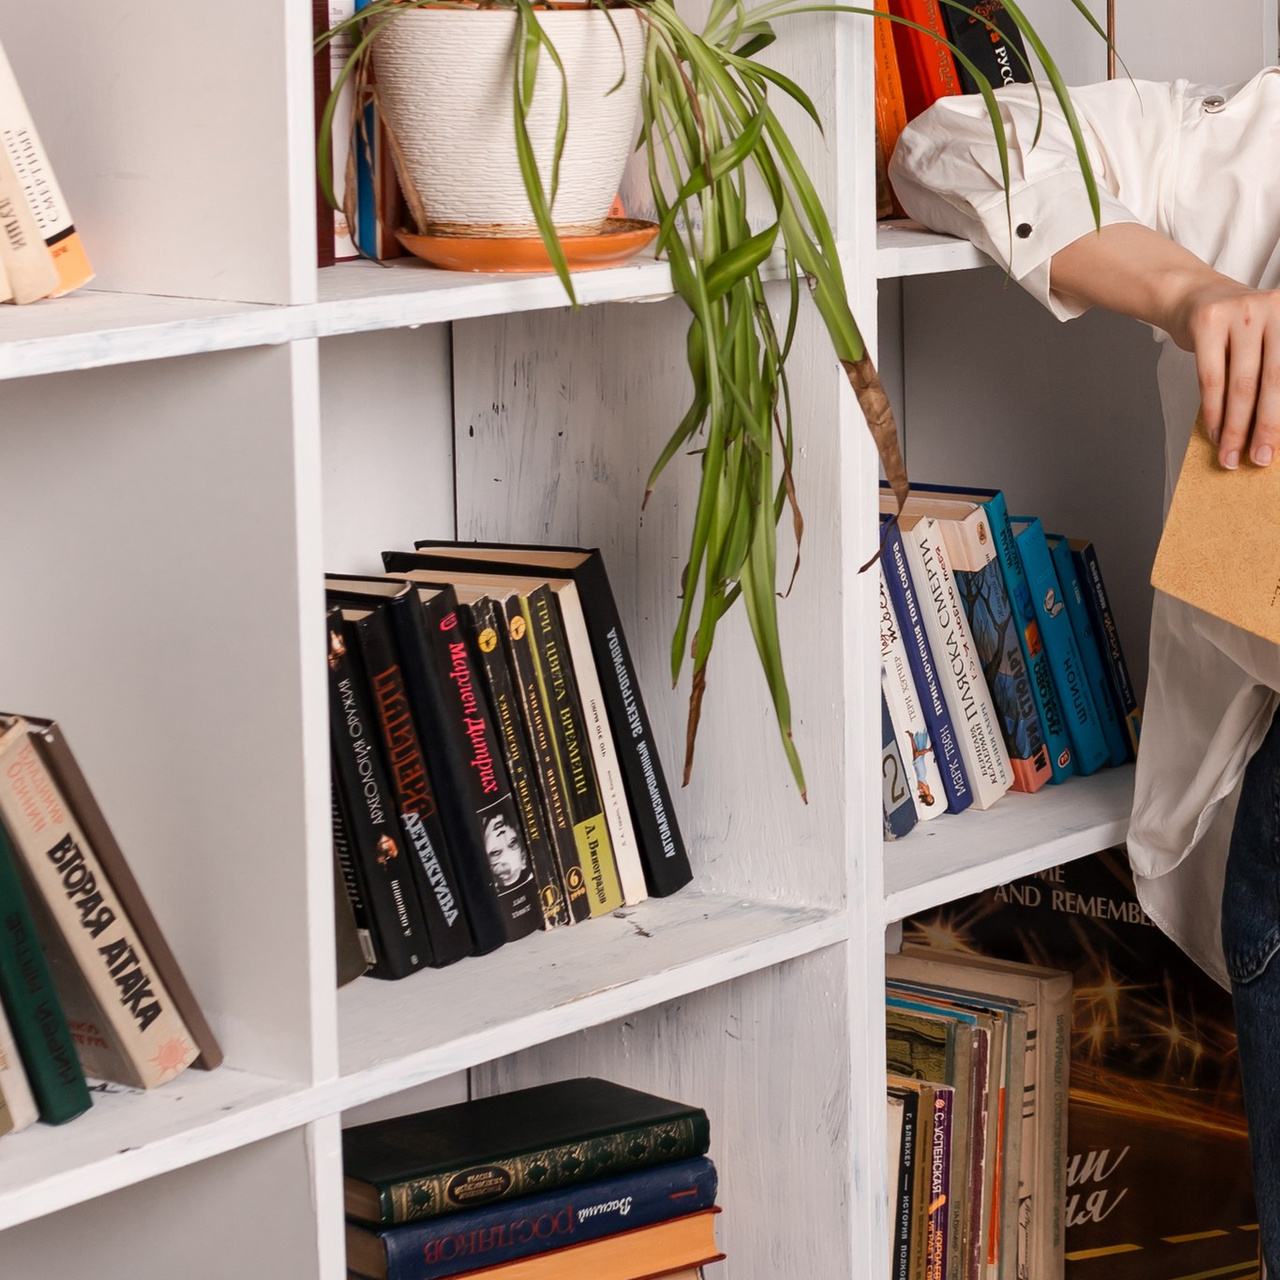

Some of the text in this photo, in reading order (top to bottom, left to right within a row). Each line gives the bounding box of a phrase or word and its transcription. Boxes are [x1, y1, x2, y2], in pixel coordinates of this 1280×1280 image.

[920, 538, 978, 722] ПЛЯСКА СМЕРТИ
[449, 641, 500, 794] Марлен Дитрих
[537, 597, 587, 795] ТРИ ЦВЕТА ВРЕМЕНИ
[891, 654, 918, 722] ТЕРИ ХЭТЧЕР
[1006, 646, 1048, 772] МЕРИ СТЮАРТ
[1032, 659, 1059, 737] ЛОГОВО
[1063, 651, 1088, 725] ШПИОН,
[336, 677, 386, 825] АРХЕОЛОГИЯ ОРУЖИЯ
[606, 627, 676, 858] АВТОМАТИЗИРОВАННЫЙ ЭЛЕКТРОПРИВОД
[974, 720, 998, 785] КЕЛЛЕРМАН
[401, 812, 459, 927] ДЕТЕКТИВА
[586, 840, 607, 905] Виноградов
[994, 885, 1041, 909] AND
[46, 833, 162, 1033] ВТОРАЯ АТАКА
[925, 1127, 948, 1194] УСПЕНСКАЯ
[424, 1191, 637, 1265] Василий РОСЛЯКОВ
[897, 1194, 912, 1240] ИСТОРИЯ
[923, 1219, 937, 1260] ИГРАЕТ
